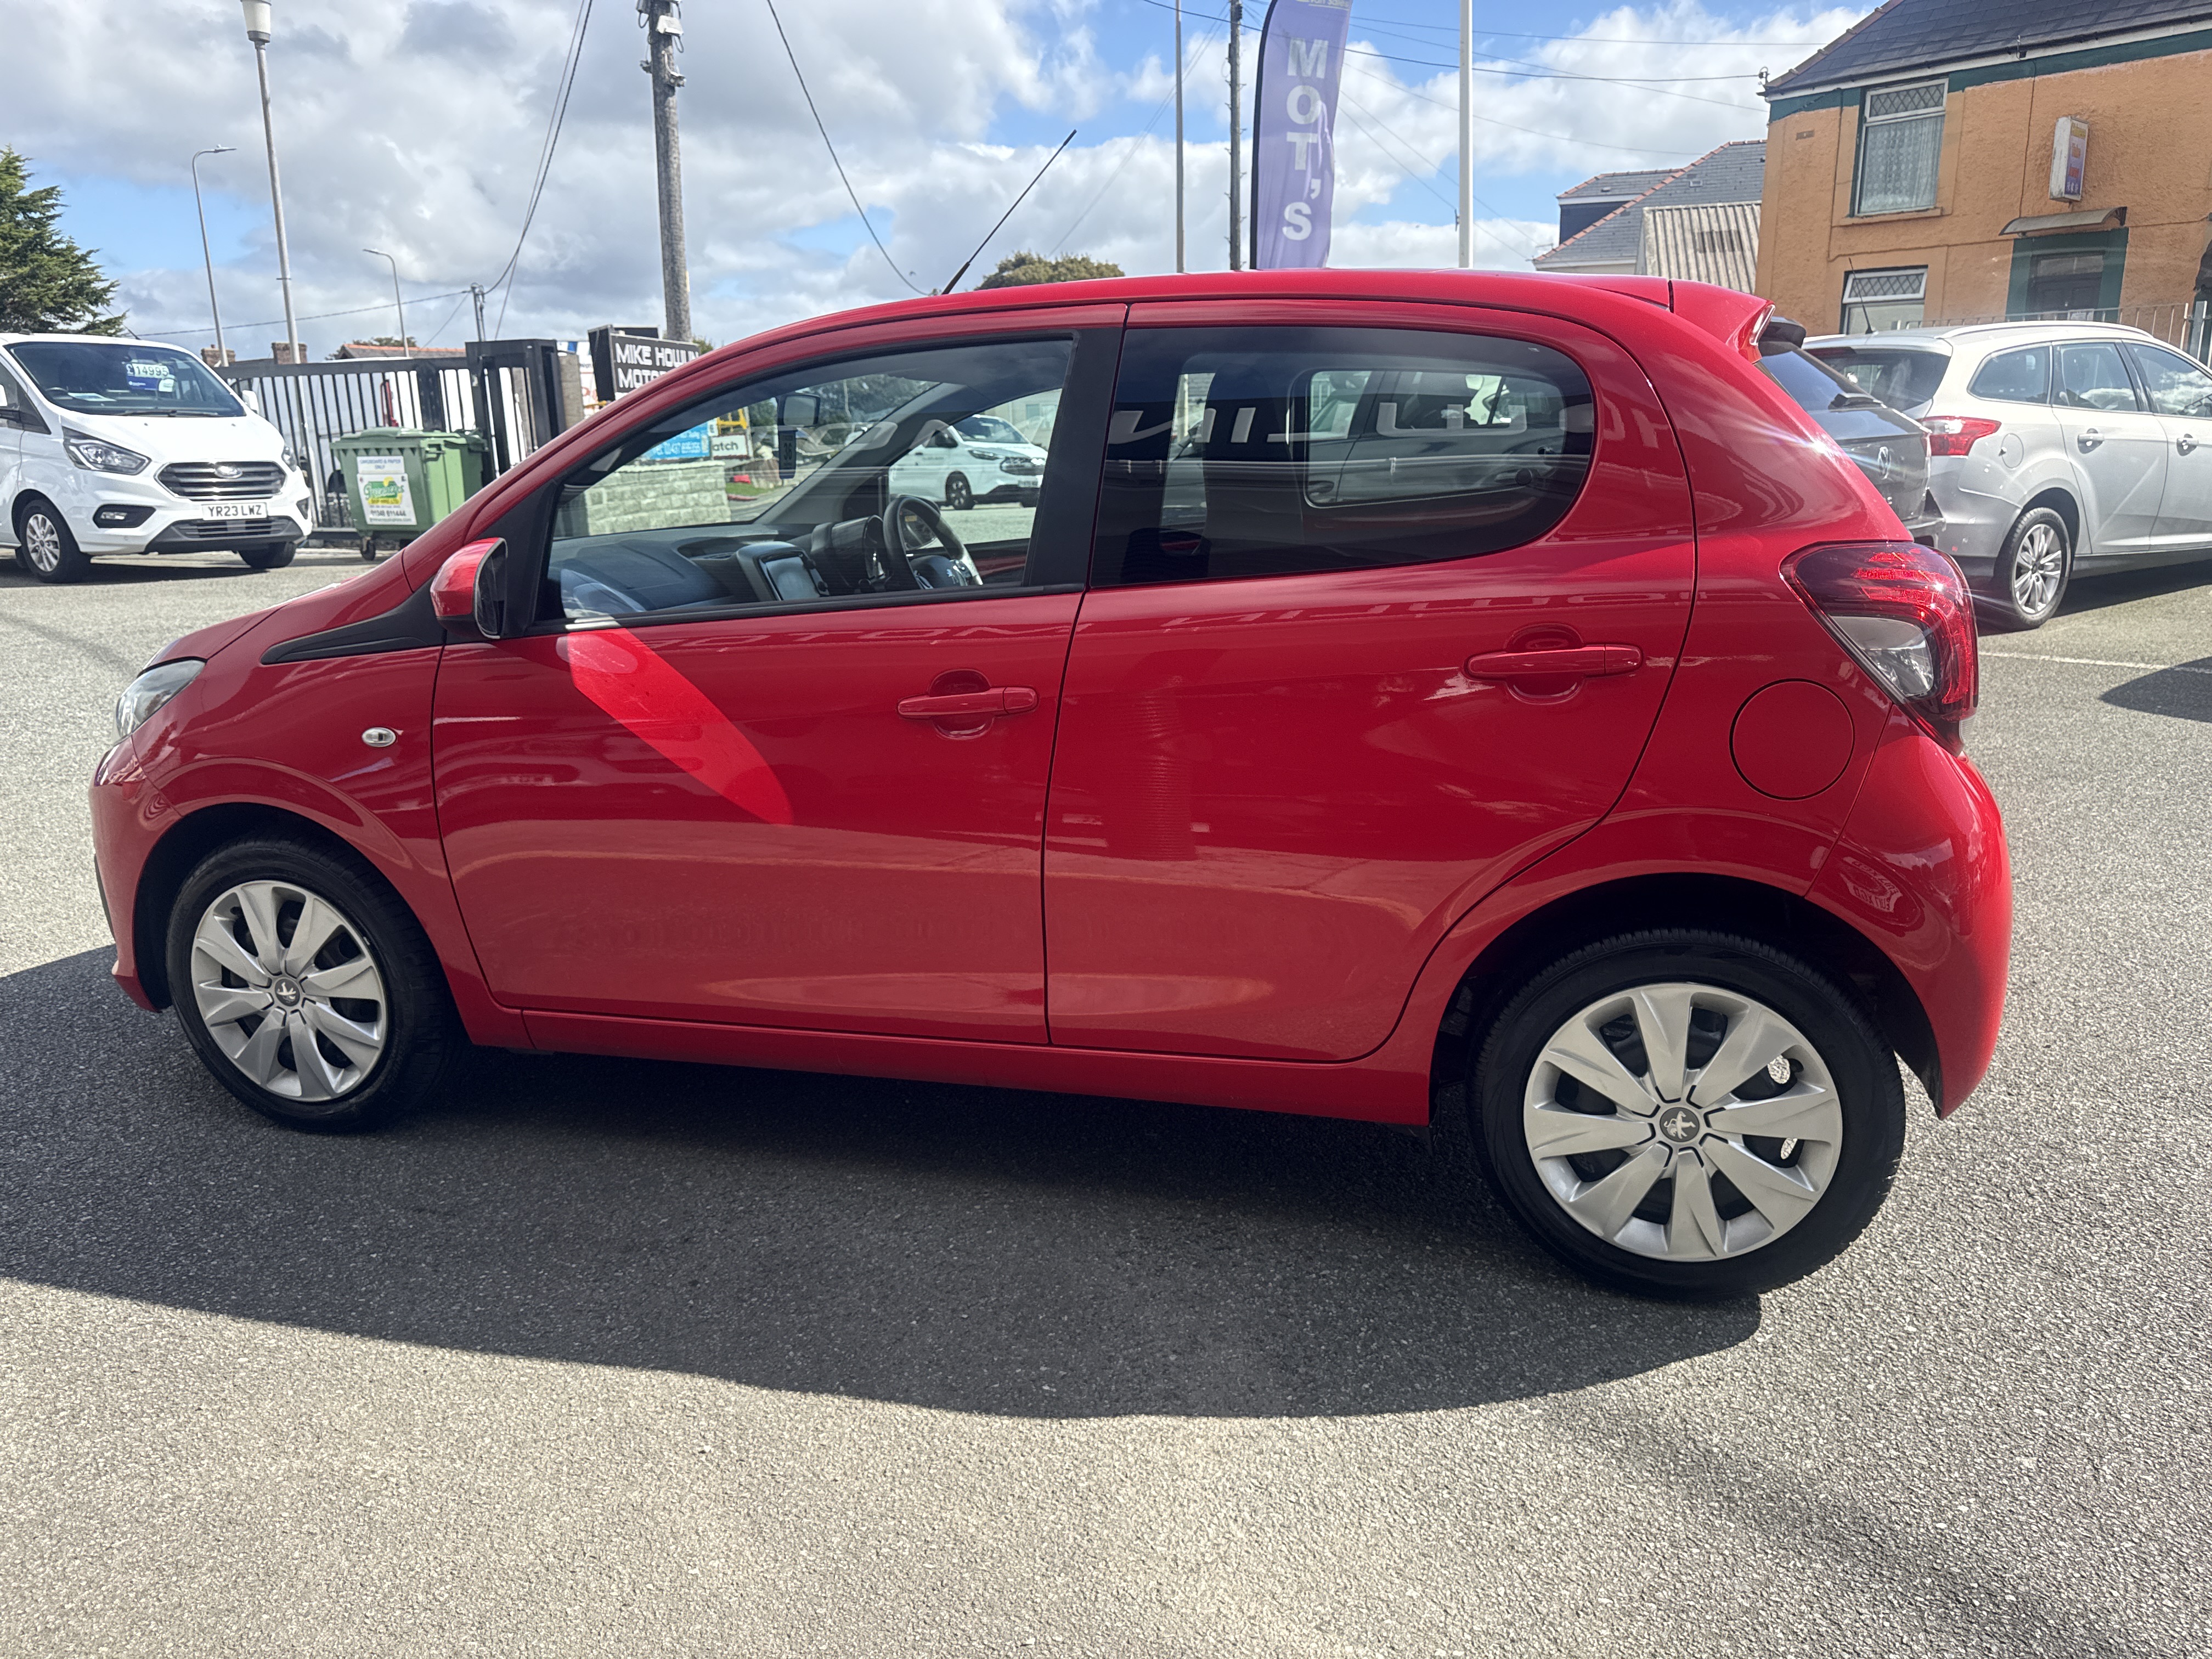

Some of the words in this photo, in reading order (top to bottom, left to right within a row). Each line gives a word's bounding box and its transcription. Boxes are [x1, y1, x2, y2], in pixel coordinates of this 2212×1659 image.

[1282, 38, 1328, 240] MOT'S
[615, 343, 652, 365] MIKE
[208, 505, 238, 517] YR23
[241, 505, 262, 516] LWZ
